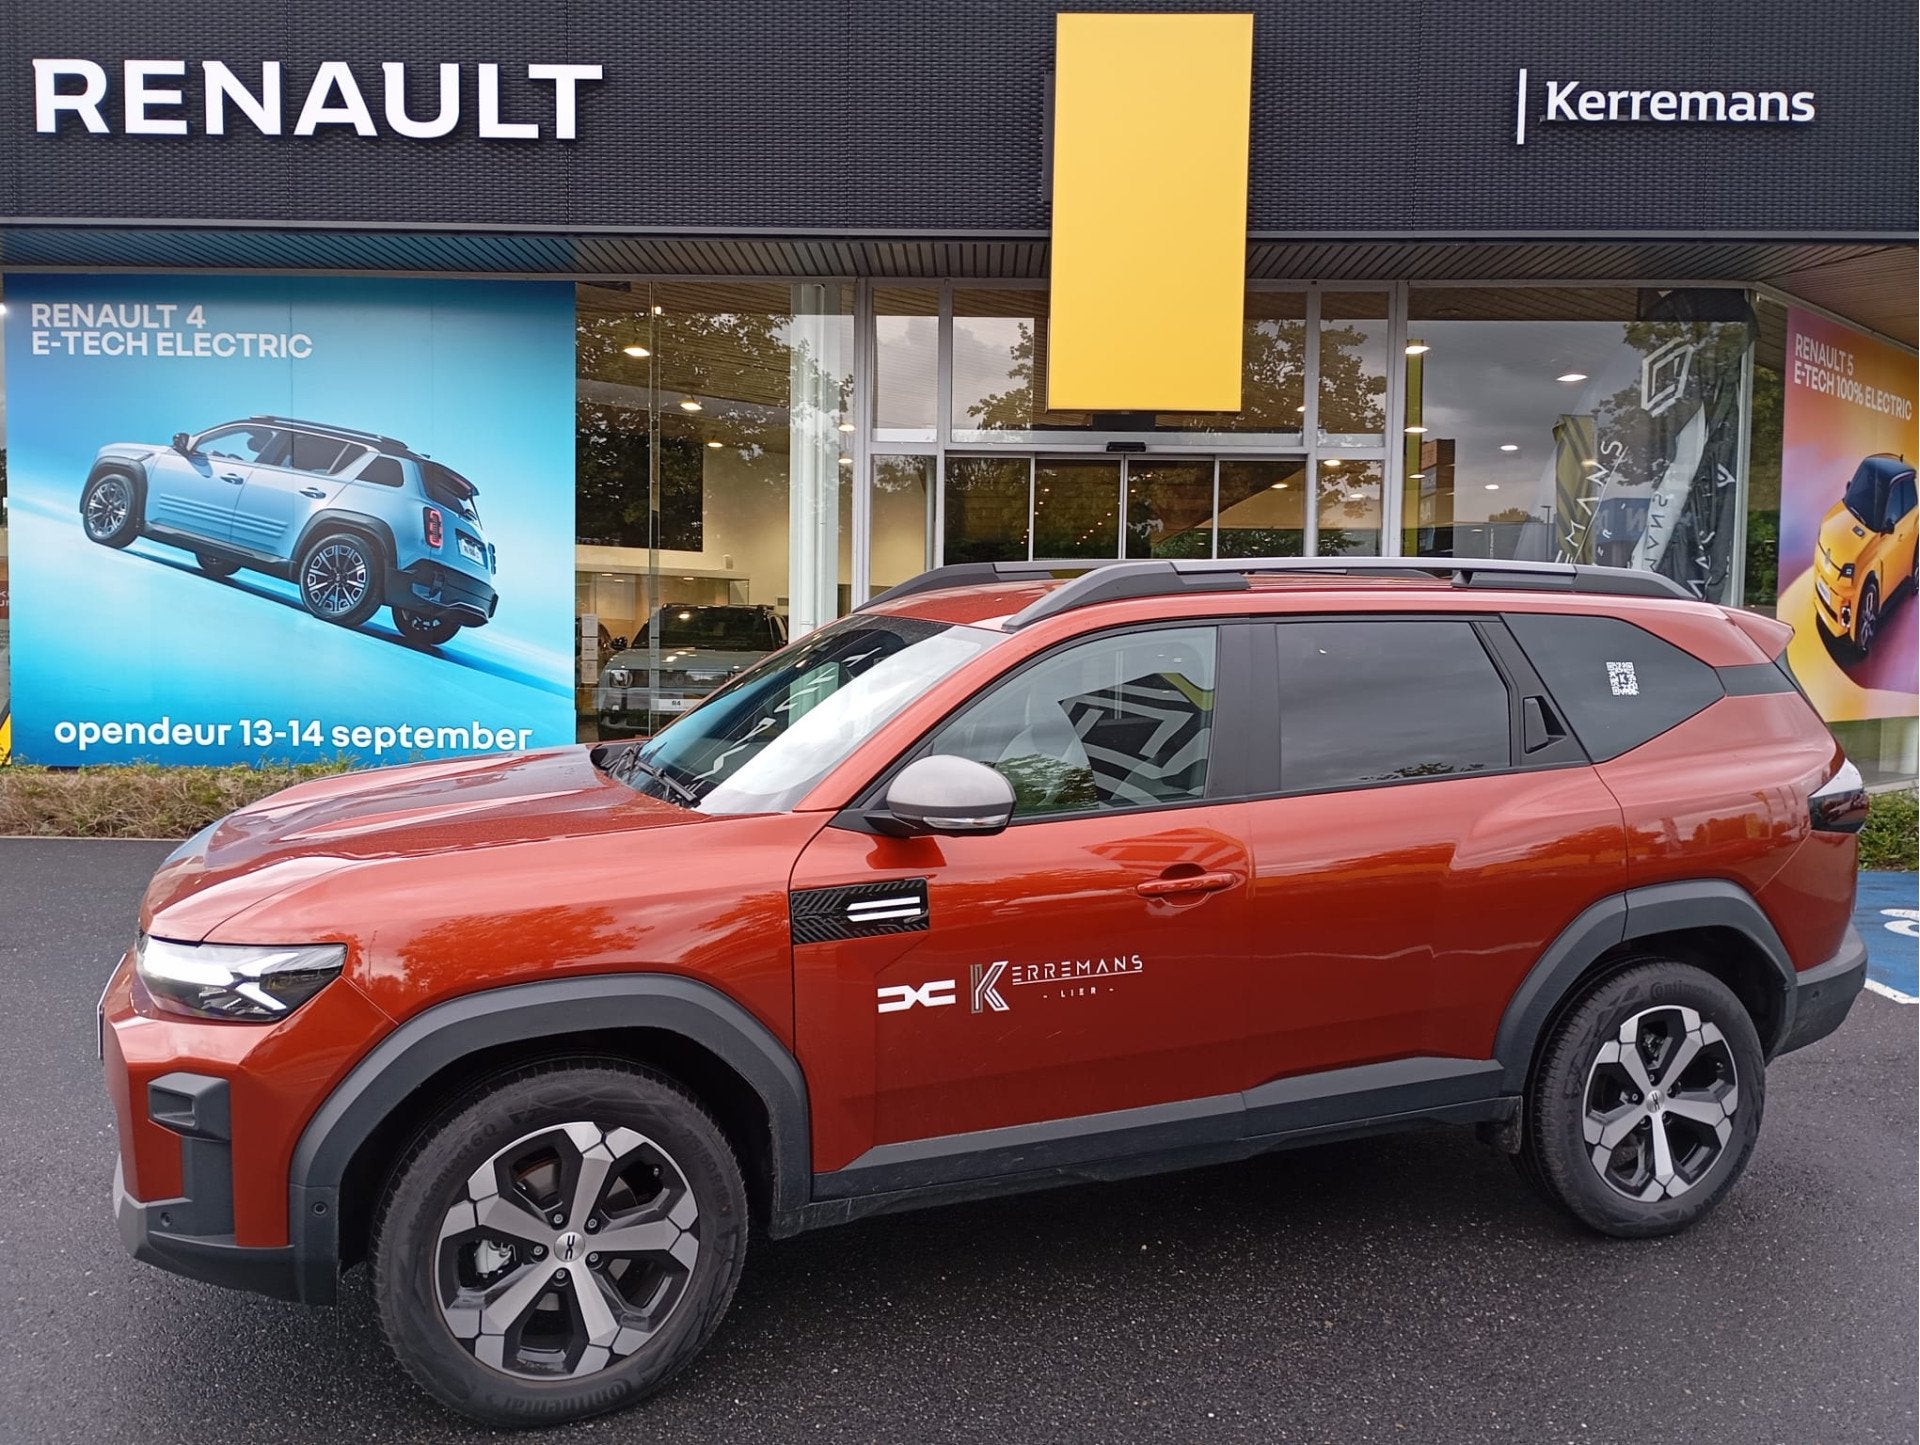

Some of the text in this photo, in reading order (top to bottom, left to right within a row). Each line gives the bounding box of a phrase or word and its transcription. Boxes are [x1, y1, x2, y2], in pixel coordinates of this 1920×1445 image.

[33, 59, 604, 140] RENAULT
[1546, 81, 1816, 122] Kerremans
[31, 303, 207, 329] RENAULT 4
[32, 331, 314, 359] E-TECH ELECTRIC
[1795, 333, 1854, 376] RENAULT 5
[1794, 360, 1912, 421] E-TECH 100% ELECTRIC
[54, 716, 534, 755] opendeur 13-14 september
[1060, 986, 1097, 998] LIER
